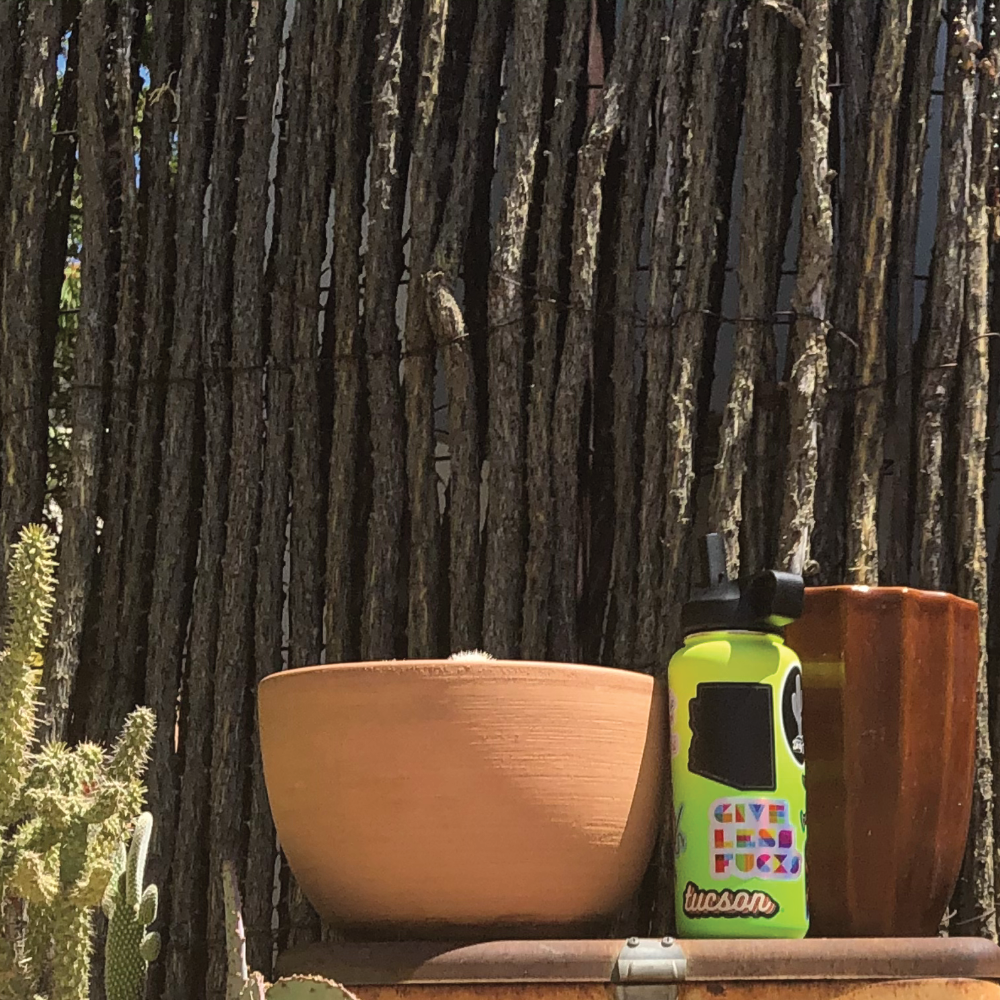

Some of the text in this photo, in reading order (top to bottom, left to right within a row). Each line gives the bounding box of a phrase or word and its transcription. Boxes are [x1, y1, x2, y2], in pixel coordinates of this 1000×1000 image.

[714, 804, 785, 824] GIVE
[714, 829, 792, 849] LESS
[715, 854, 800, 873] FUCKS
[684, 884, 776, 914] tucson
